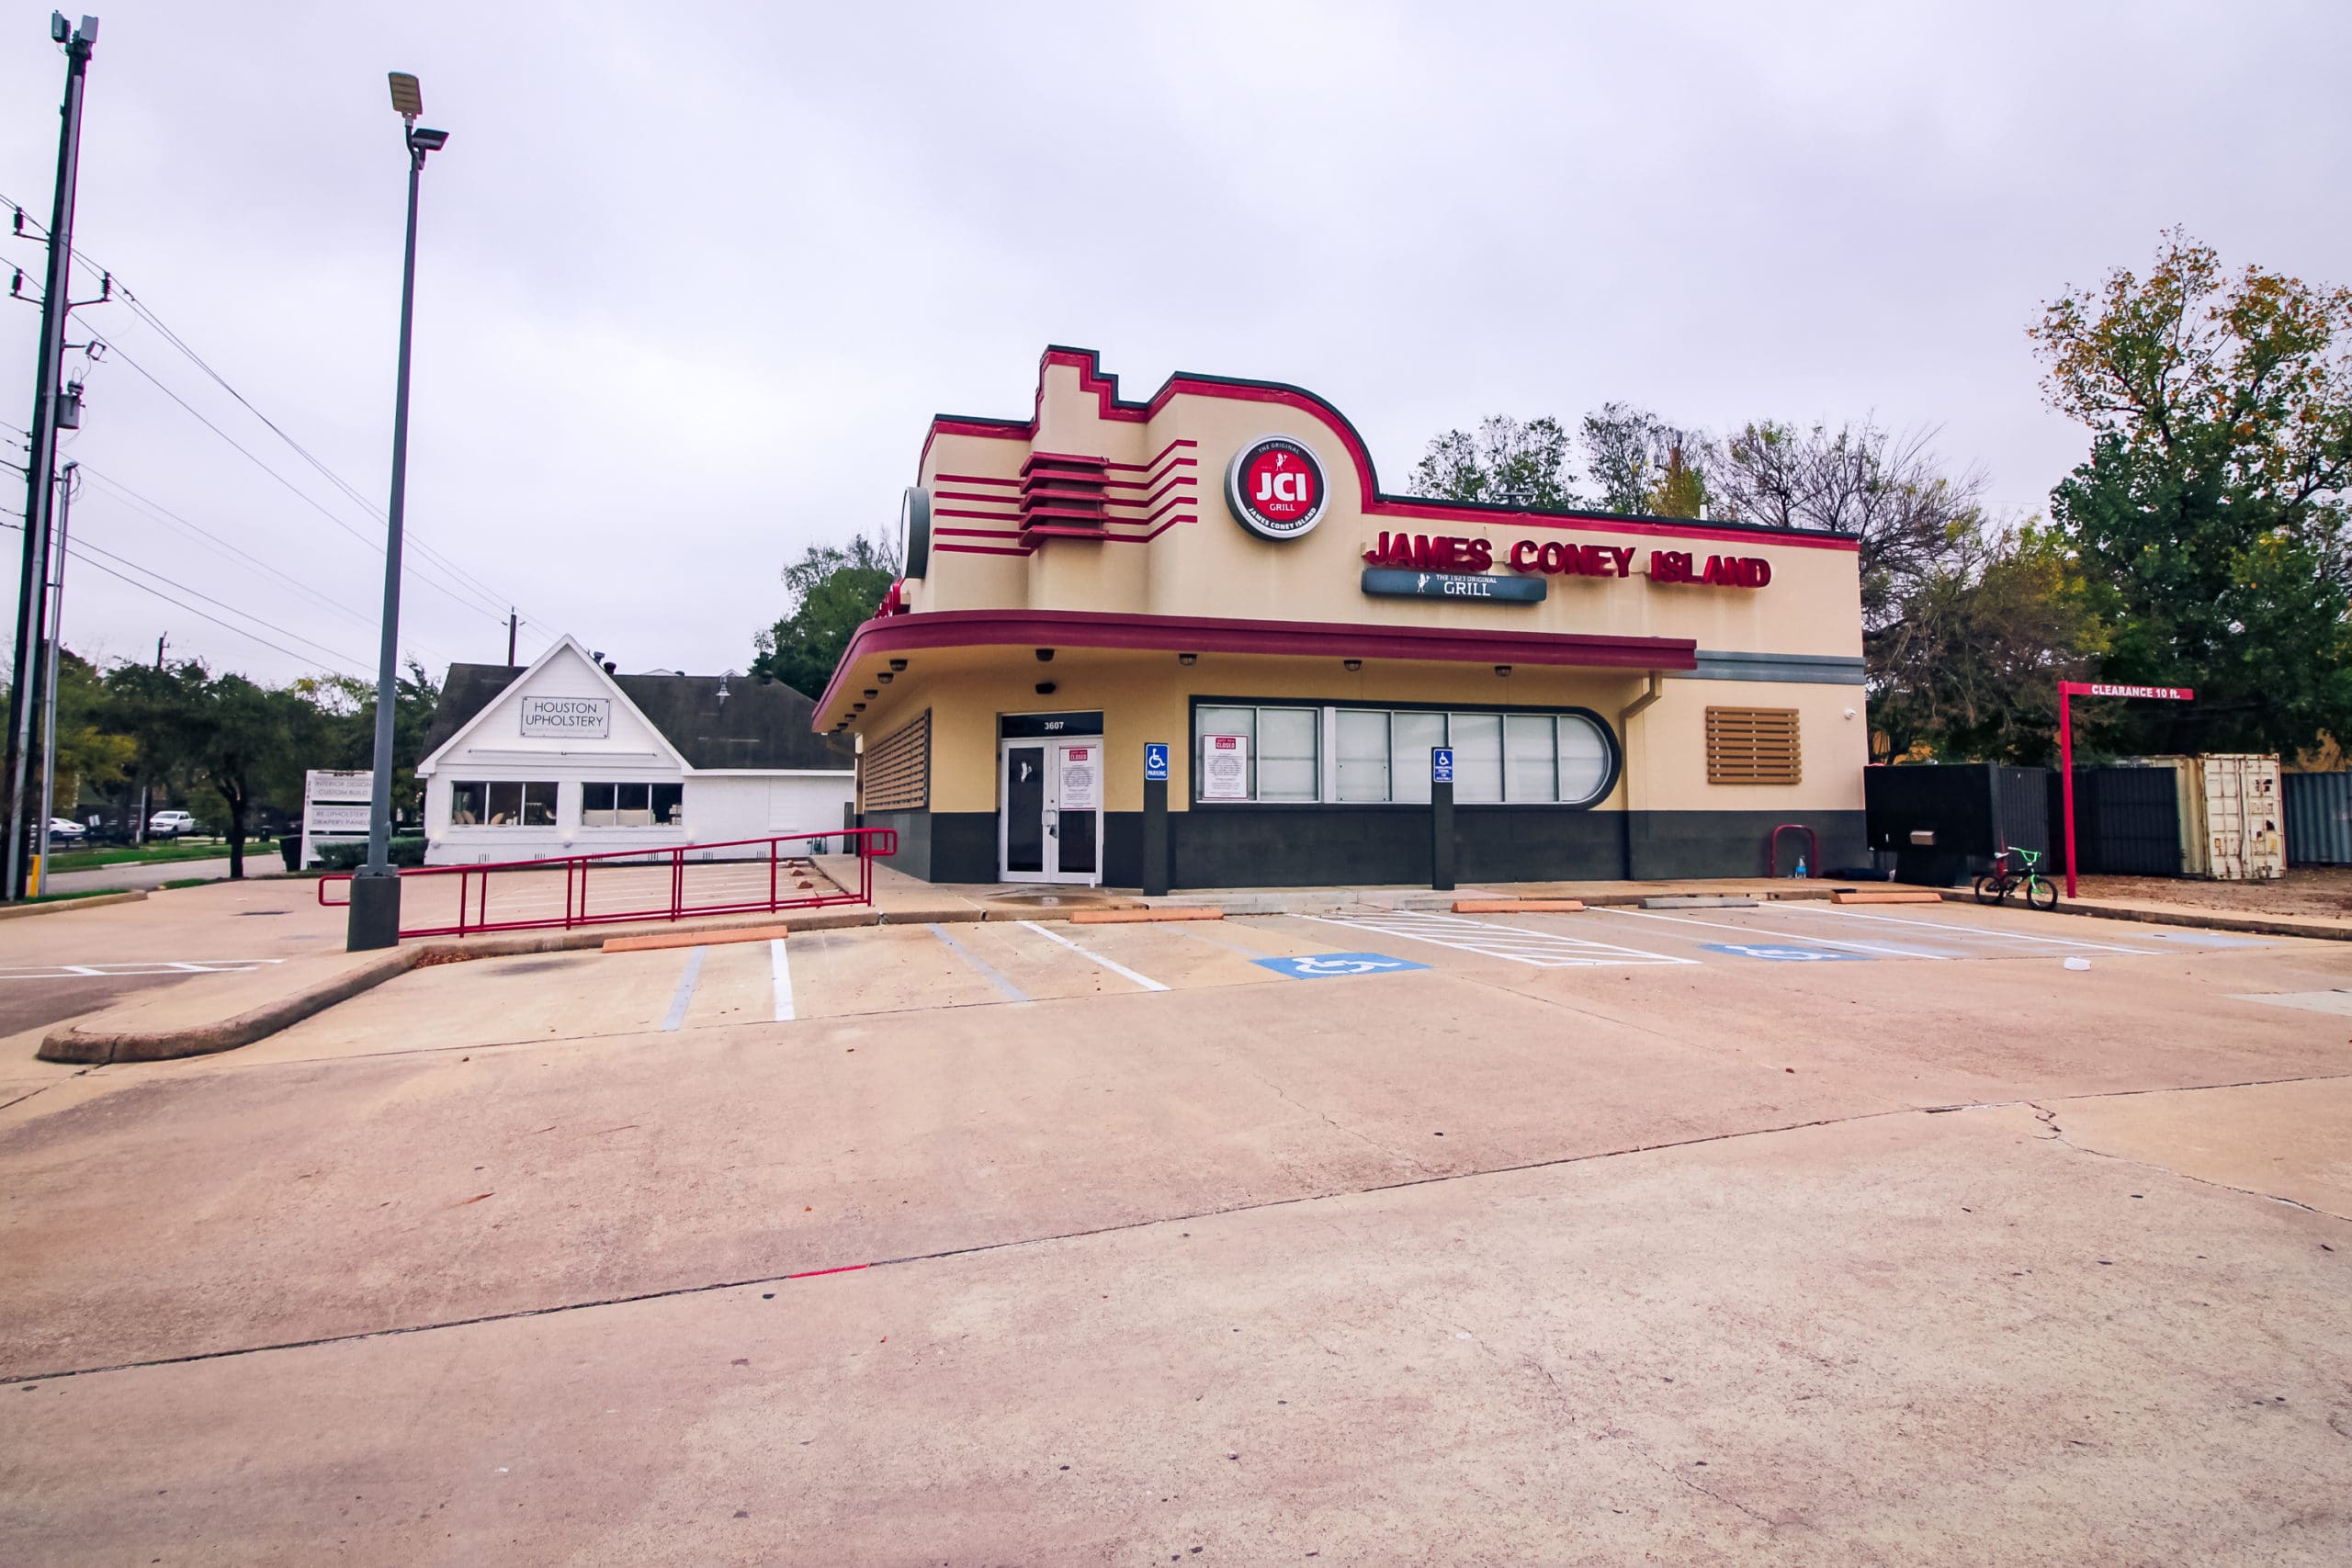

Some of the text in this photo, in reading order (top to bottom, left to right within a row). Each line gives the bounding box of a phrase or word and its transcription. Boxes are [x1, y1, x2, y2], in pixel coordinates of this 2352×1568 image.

[1259, 443, 1300, 454] THE ORIGINAL
[1256, 472, 1307, 502] JCI
[1270, 503, 1295, 512] GRILL
[1249, 507, 1317, 530] JAMES CONEY ISLAND
[1365, 531, 1771, 588] JAMES CONEY ISLAND
[1443, 581, 1491, 596] GRILL
[2092, 684, 2180, 699] CLEARANCE 10 ft.
[535, 702, 597, 714] HOUSTON
[526, 715, 603, 727] UPHOLSTERY
[1044, 721, 1065, 730] 3607
